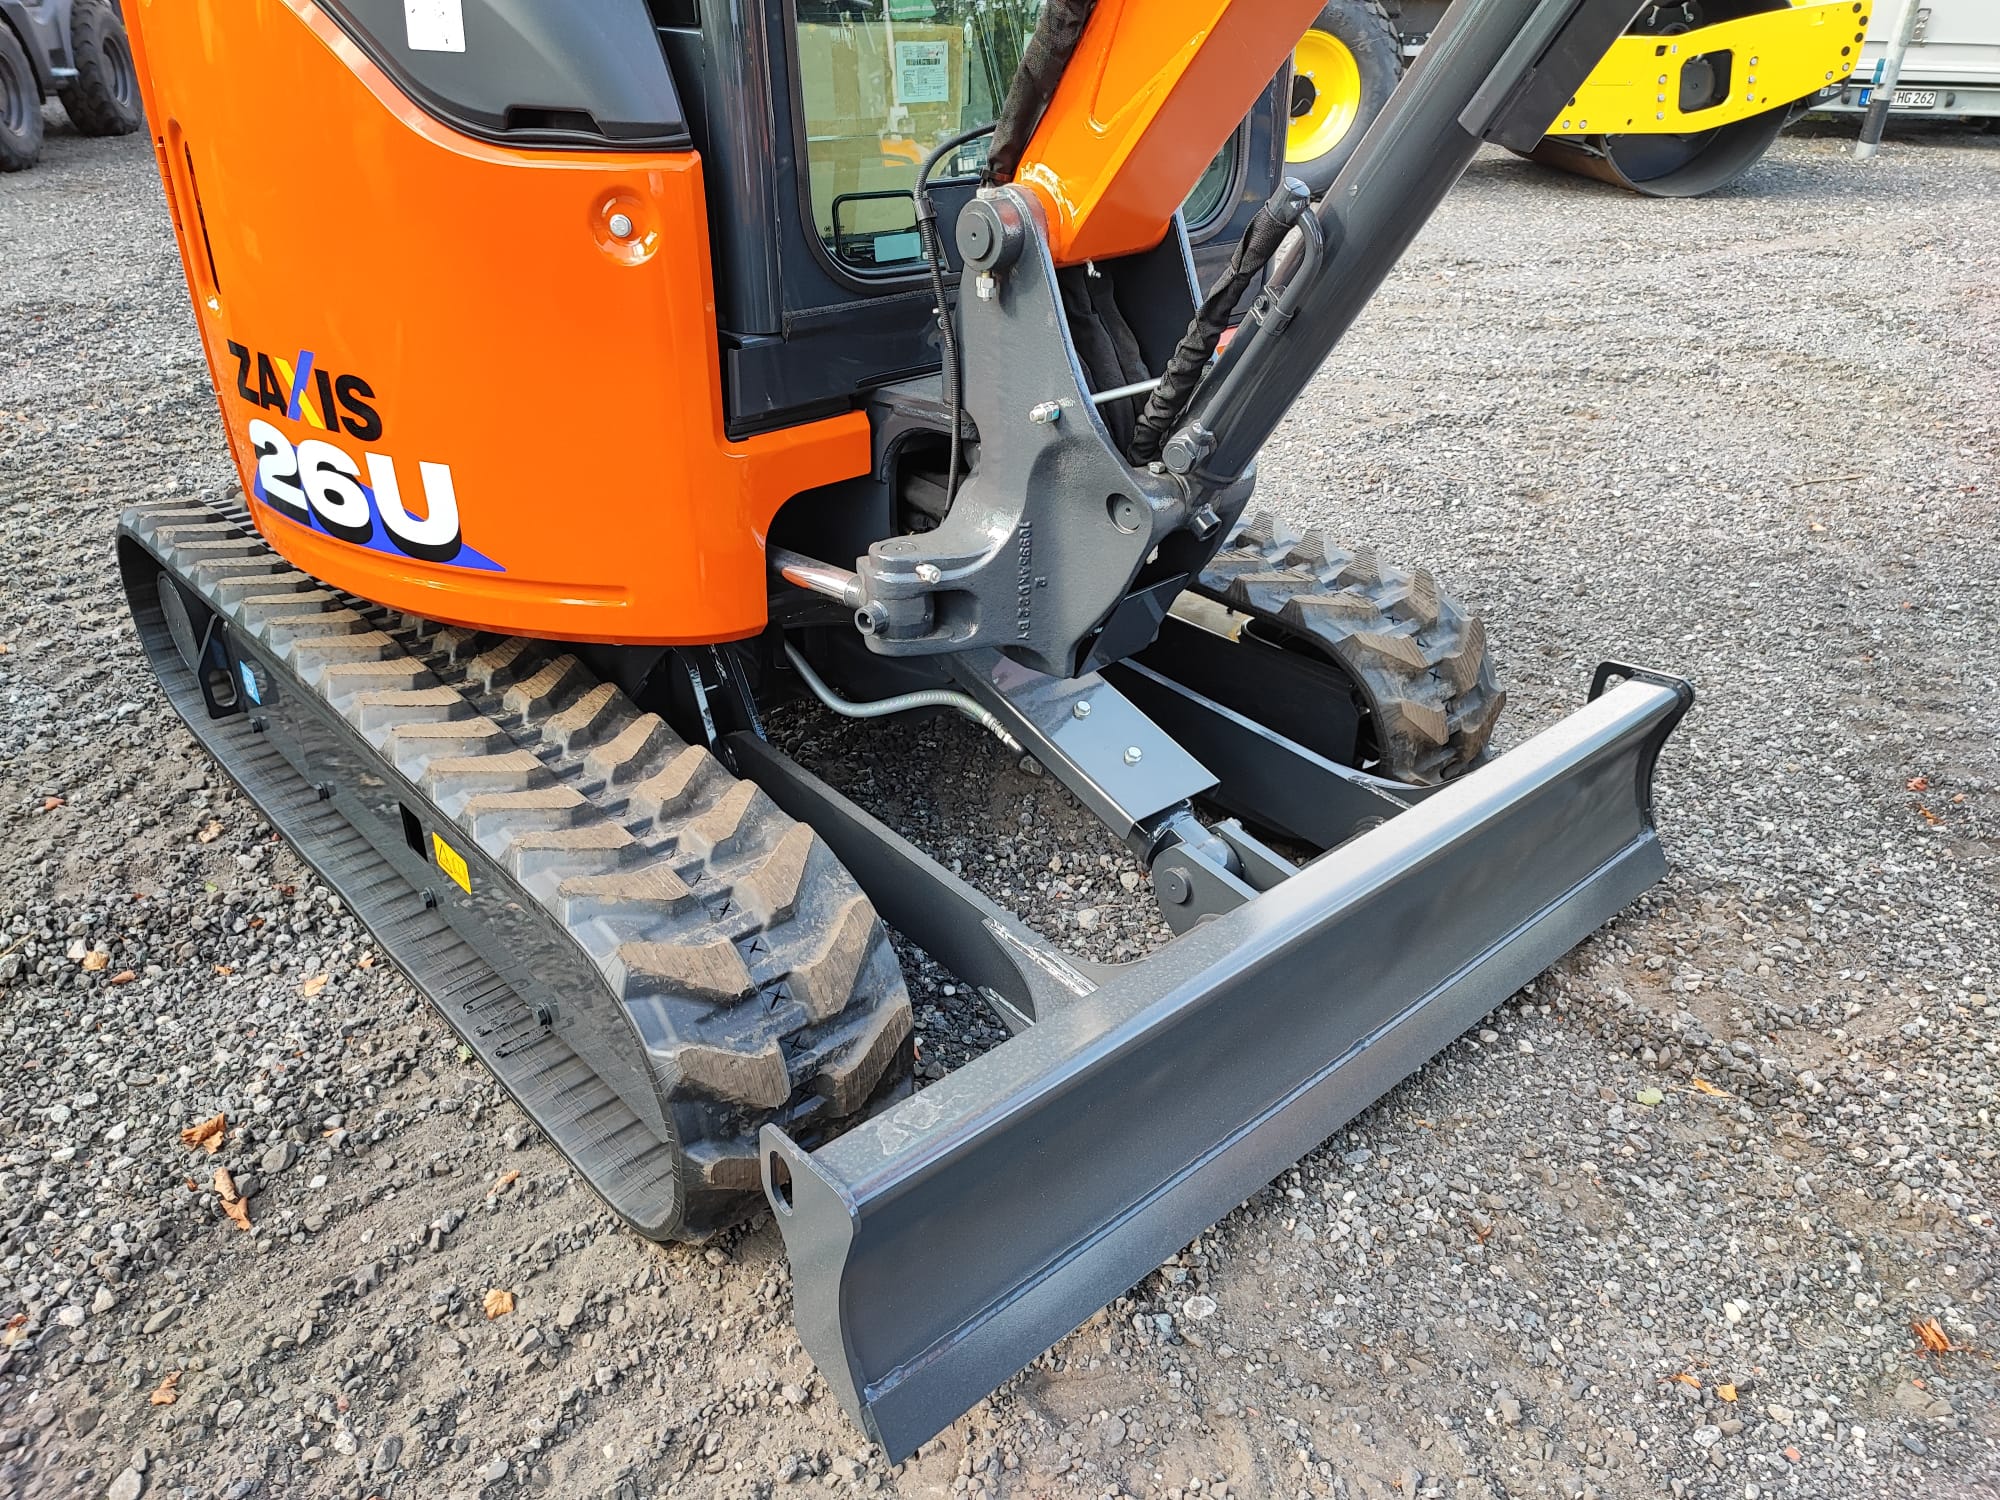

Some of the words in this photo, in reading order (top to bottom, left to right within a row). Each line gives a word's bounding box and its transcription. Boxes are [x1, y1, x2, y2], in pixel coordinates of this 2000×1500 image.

[1896, 92, 1912, 104] HG
[1913, 92, 1935, 104] 262
[227, 339, 382, 441] ZAXIS
[249, 418, 461, 561] 26U
